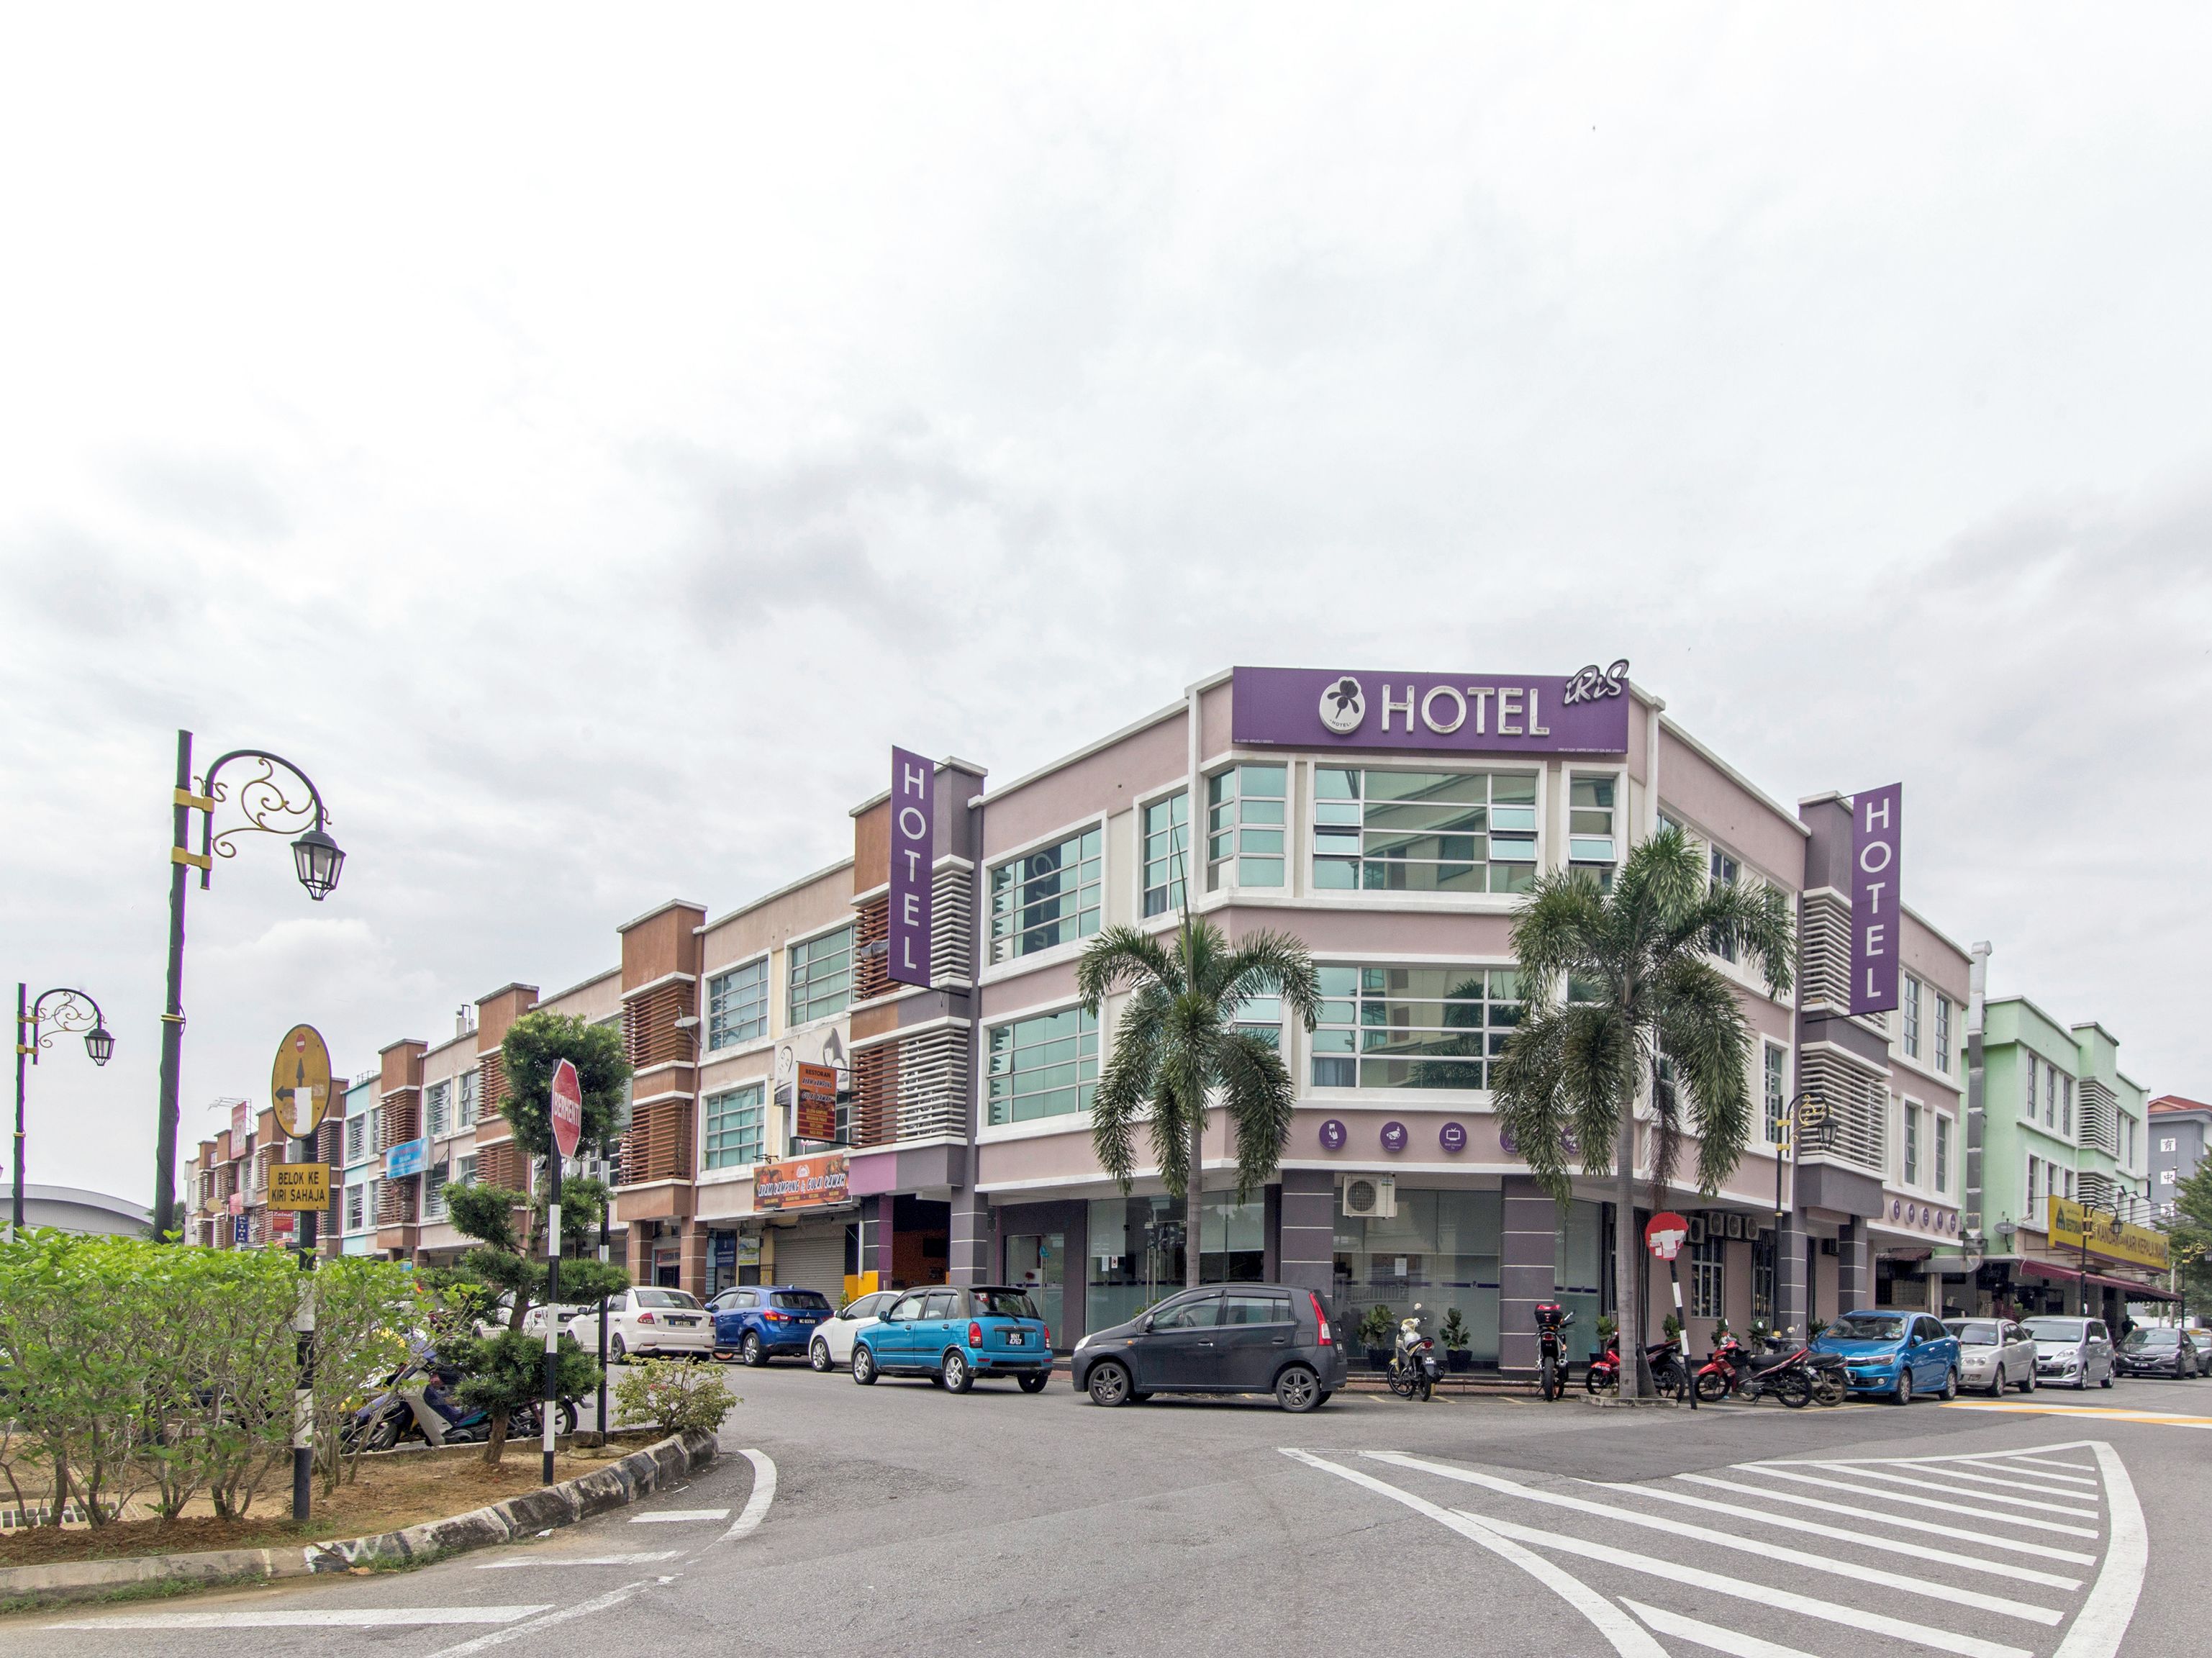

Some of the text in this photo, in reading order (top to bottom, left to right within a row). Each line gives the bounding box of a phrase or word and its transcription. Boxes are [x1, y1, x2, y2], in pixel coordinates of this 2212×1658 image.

[1382, 684, 1550, 736] HOTEL
[899, 762, 926, 969] HOTEL
[1860, 797, 1891, 998] HOTEL
[554, 1091, 580, 1128] BERHENTI
[271, 1189, 325, 1202] KIRI SAHAJA
[278, 1171, 319, 1185] BELOK KE
